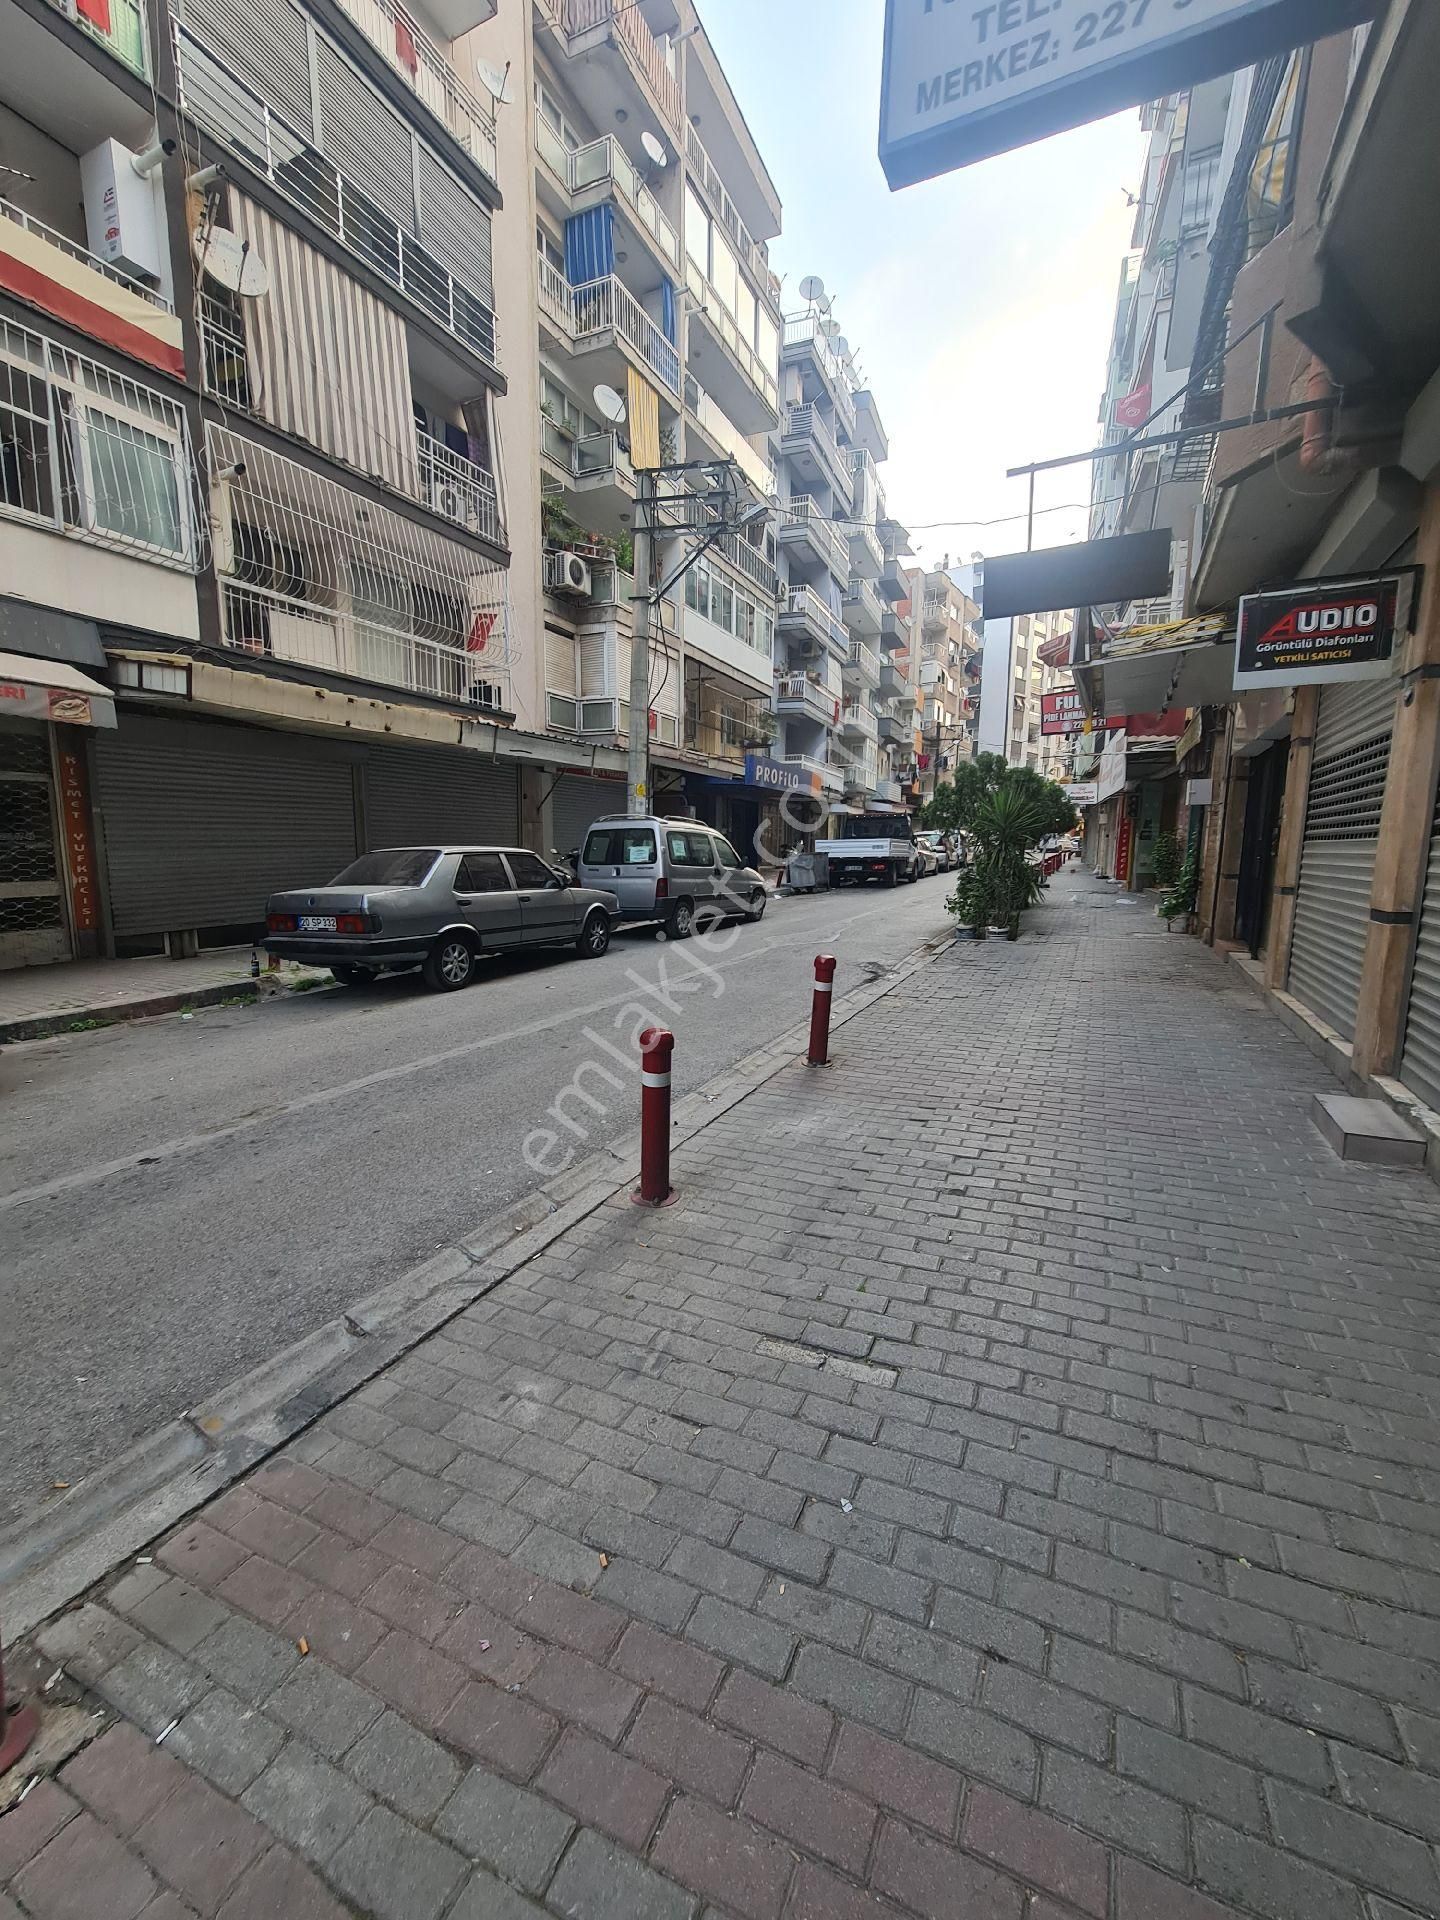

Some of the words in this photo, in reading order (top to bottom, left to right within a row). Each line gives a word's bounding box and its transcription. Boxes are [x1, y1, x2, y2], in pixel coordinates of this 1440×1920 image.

[916, 29, 1060, 114] MERKEZ:
[1073, 0, 1153, 52] 227
[1258, 604, 1378, 641] AUDIO
[1256, 637, 1313, 653] Görüntülü
[1315, 633, 1374, 648] Diafonları
